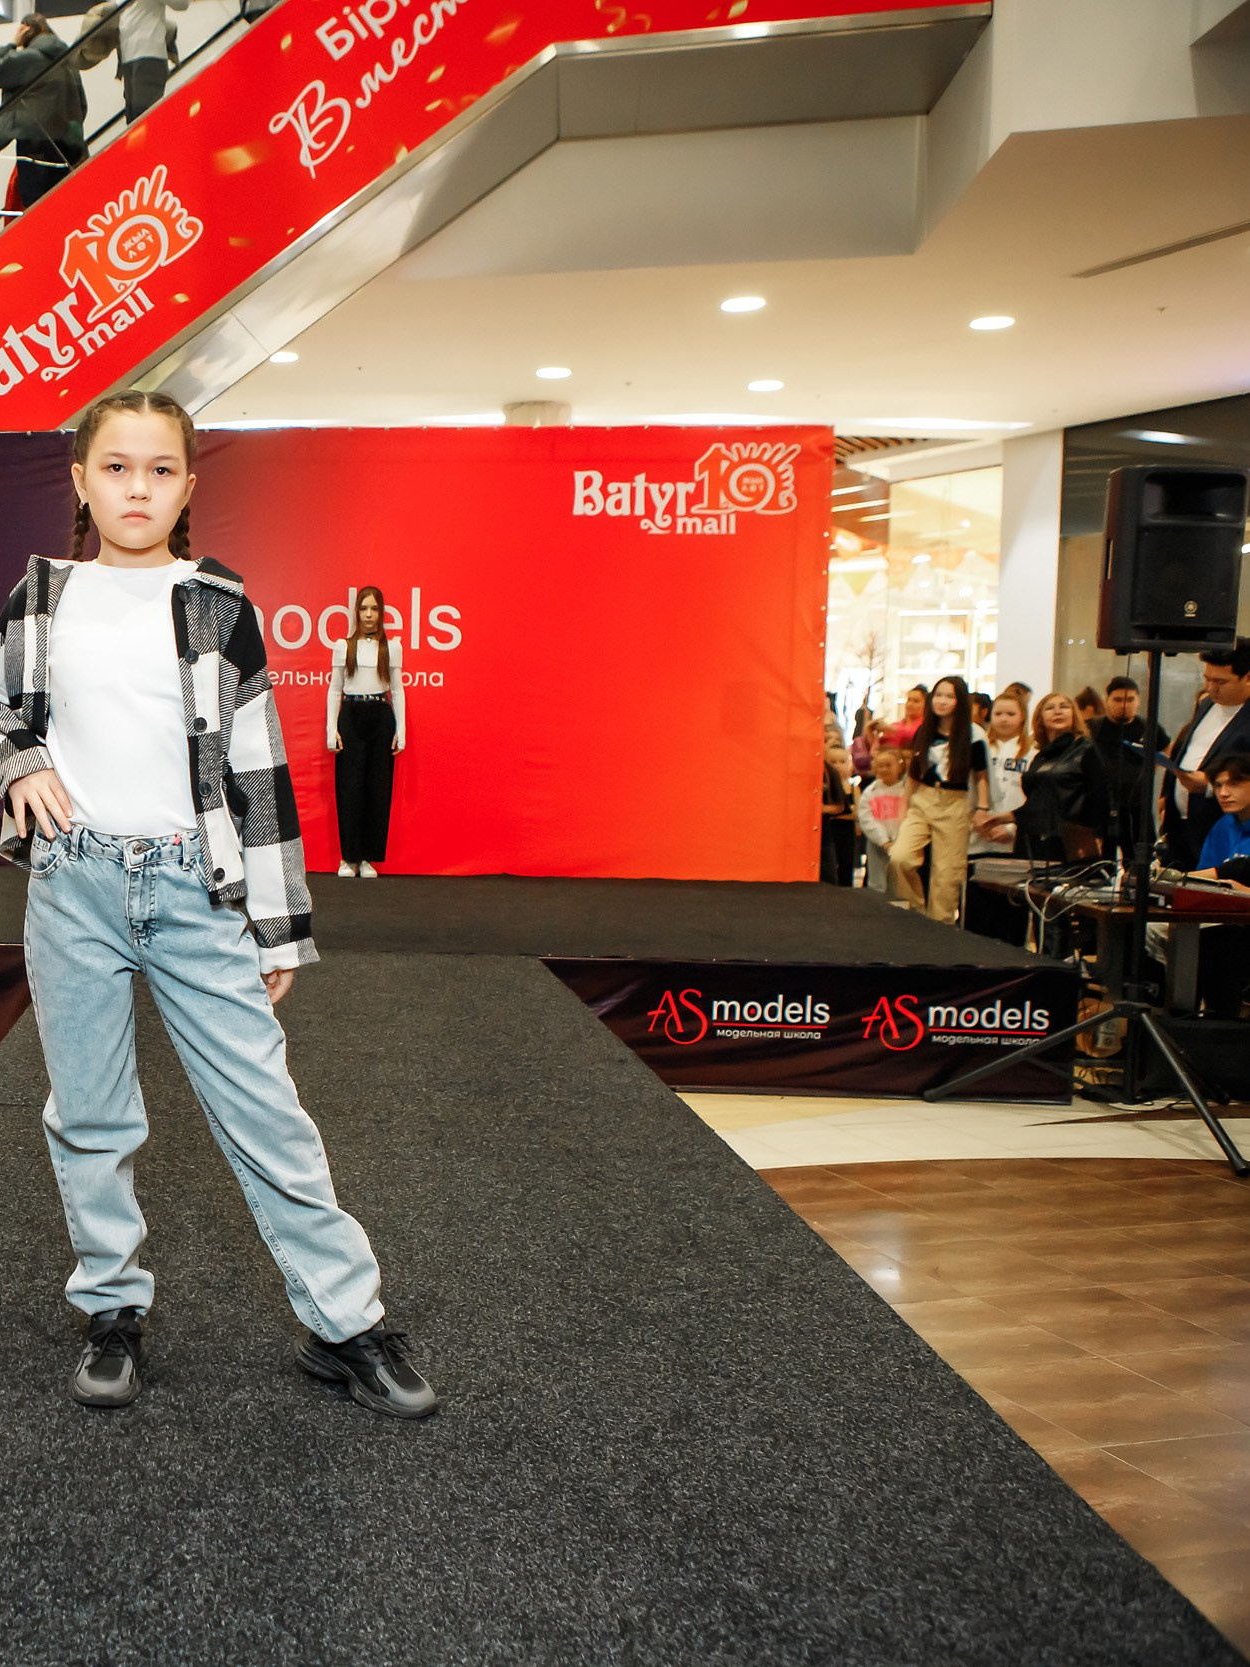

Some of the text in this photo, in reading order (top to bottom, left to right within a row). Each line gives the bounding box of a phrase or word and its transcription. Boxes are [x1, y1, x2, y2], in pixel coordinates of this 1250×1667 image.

[315, 0, 410, 61] Бір
[77, 287, 155, 356] mall
[573, 470, 696, 531] Batyr
[676, 513, 736, 535] mall
[253, 587, 462, 650] odels
[401, 671, 444, 687] ола
[712, 994, 830, 1024] models
[928, 1000, 1050, 1030] models
[716, 1028, 821, 1040] модельная школа
[932, 1035, 999, 1046] модельная
